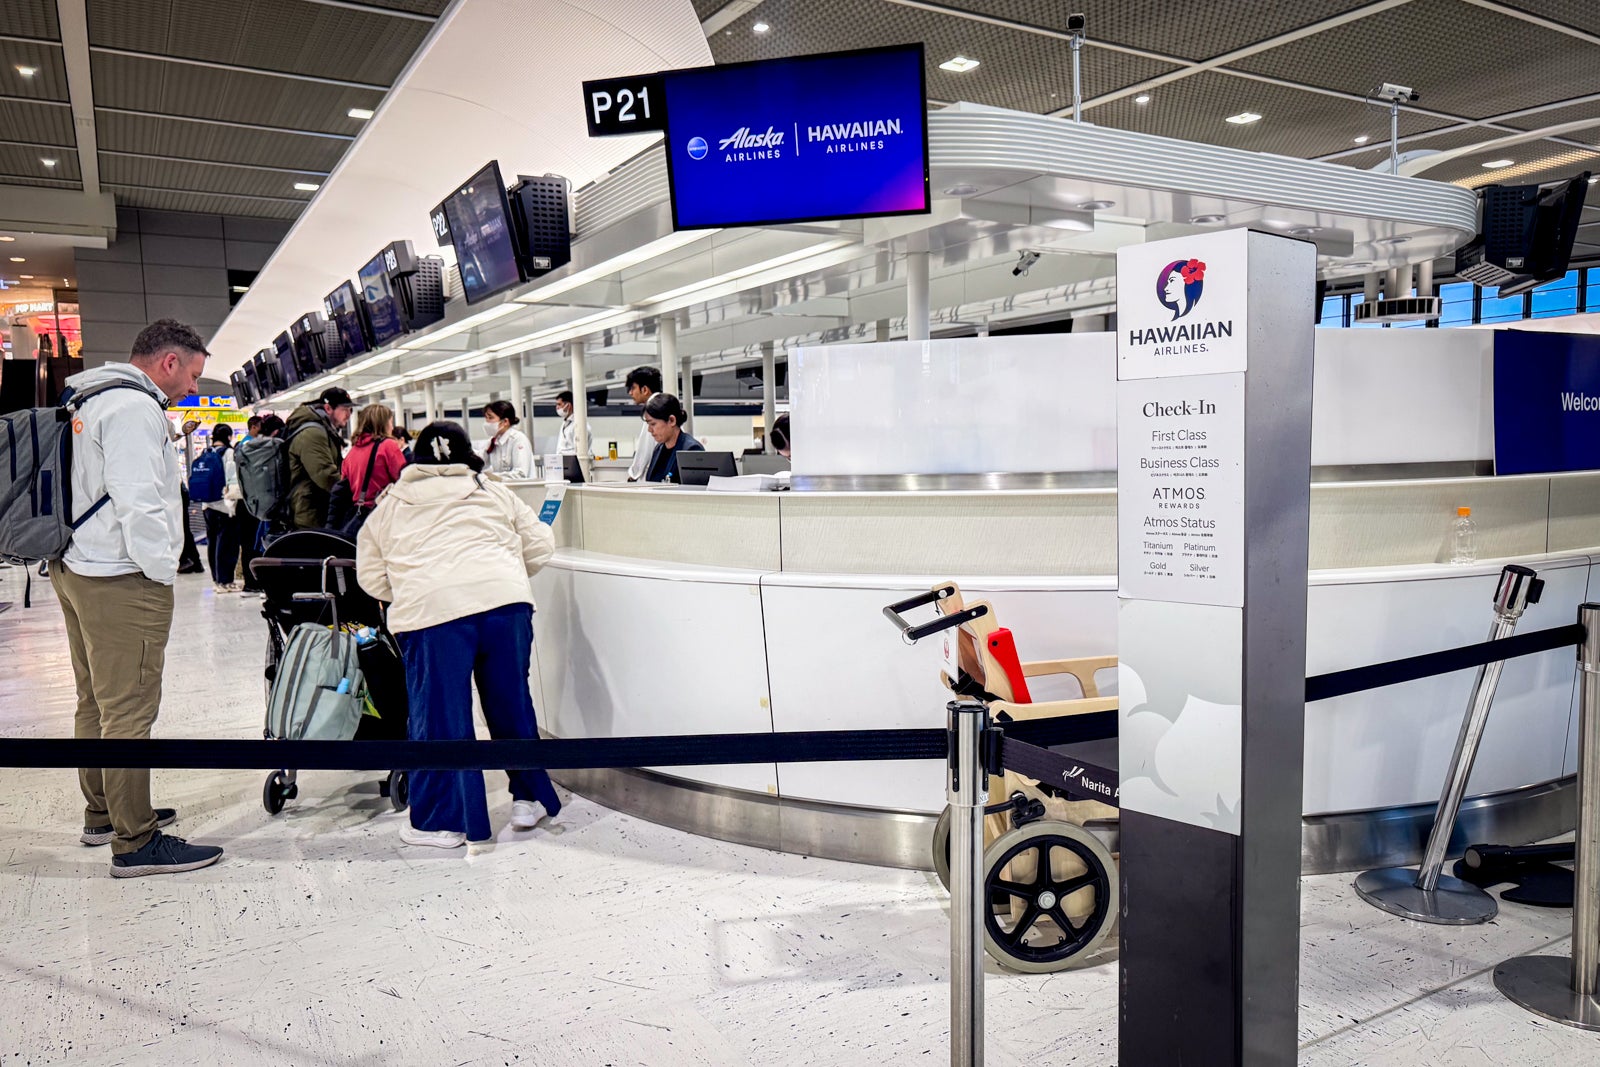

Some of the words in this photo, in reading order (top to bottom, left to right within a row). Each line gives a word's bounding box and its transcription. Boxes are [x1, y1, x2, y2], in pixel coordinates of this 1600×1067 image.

[827, 140, 884, 154] AIRLINES
[725, 149, 781, 163] AIRLINES
[1129, 320, 1233, 346] HAWAIIAN
[1142, 399, 1216, 418] Check-In
[1152, 430, 1175, 442] First
[1177, 429, 1207, 441] Class
[1140, 457, 1187, 469] Business
[1189, 456, 1220, 468] Class
[1152, 487, 1206, 500] ATMOS
[1158, 502, 1200, 510] REWARDS
[1143, 515, 1178, 528] Atmos
[1180, 516, 1216, 529] Status
[1143, 541, 1174, 550] Titanium
[1183, 542, 1216, 552] Platinum
[1149, 561, 1167, 570] Gold
[1189, 563, 1210, 573] Silver
[1081, 776, 1111, 796] Narita
